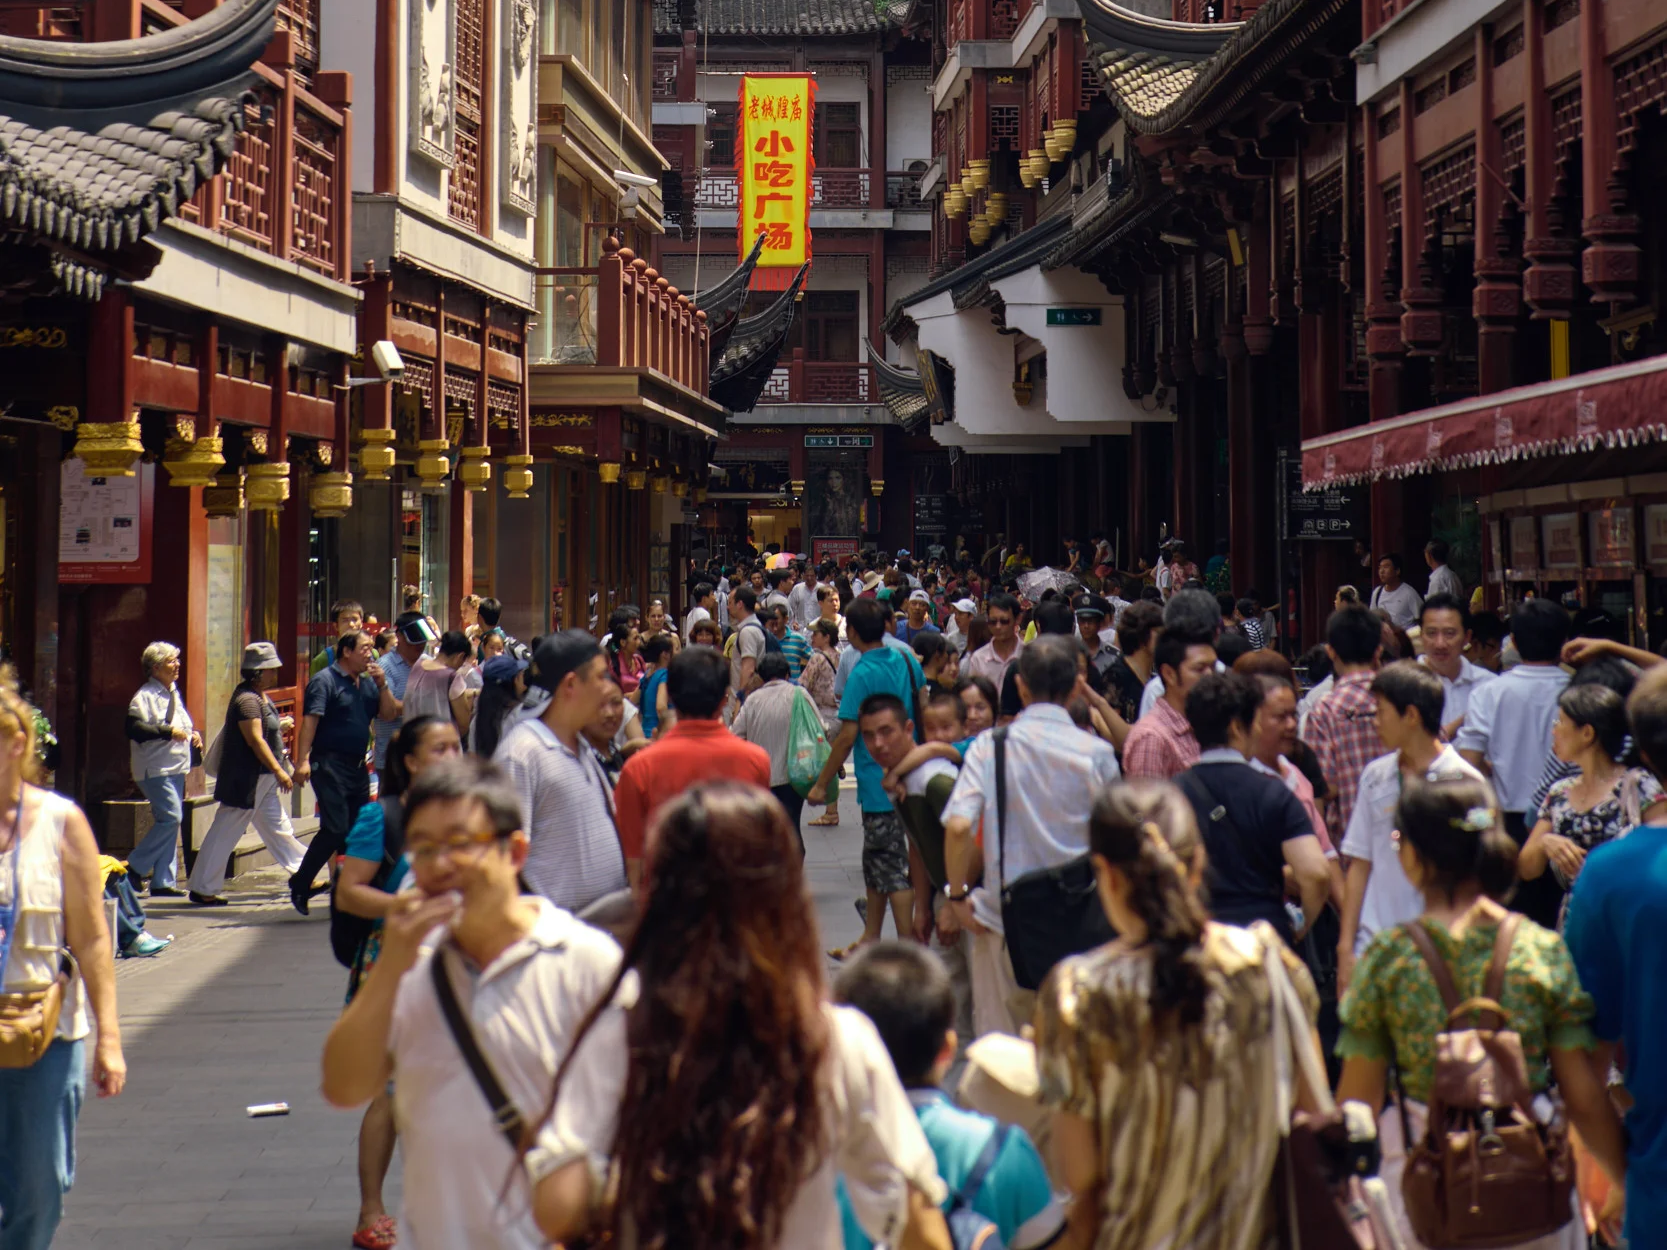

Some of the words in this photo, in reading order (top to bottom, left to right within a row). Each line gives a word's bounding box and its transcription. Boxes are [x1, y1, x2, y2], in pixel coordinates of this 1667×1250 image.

[748, 94, 802, 122] 老城隍庙
[754, 130, 795, 250] 小吃广场
